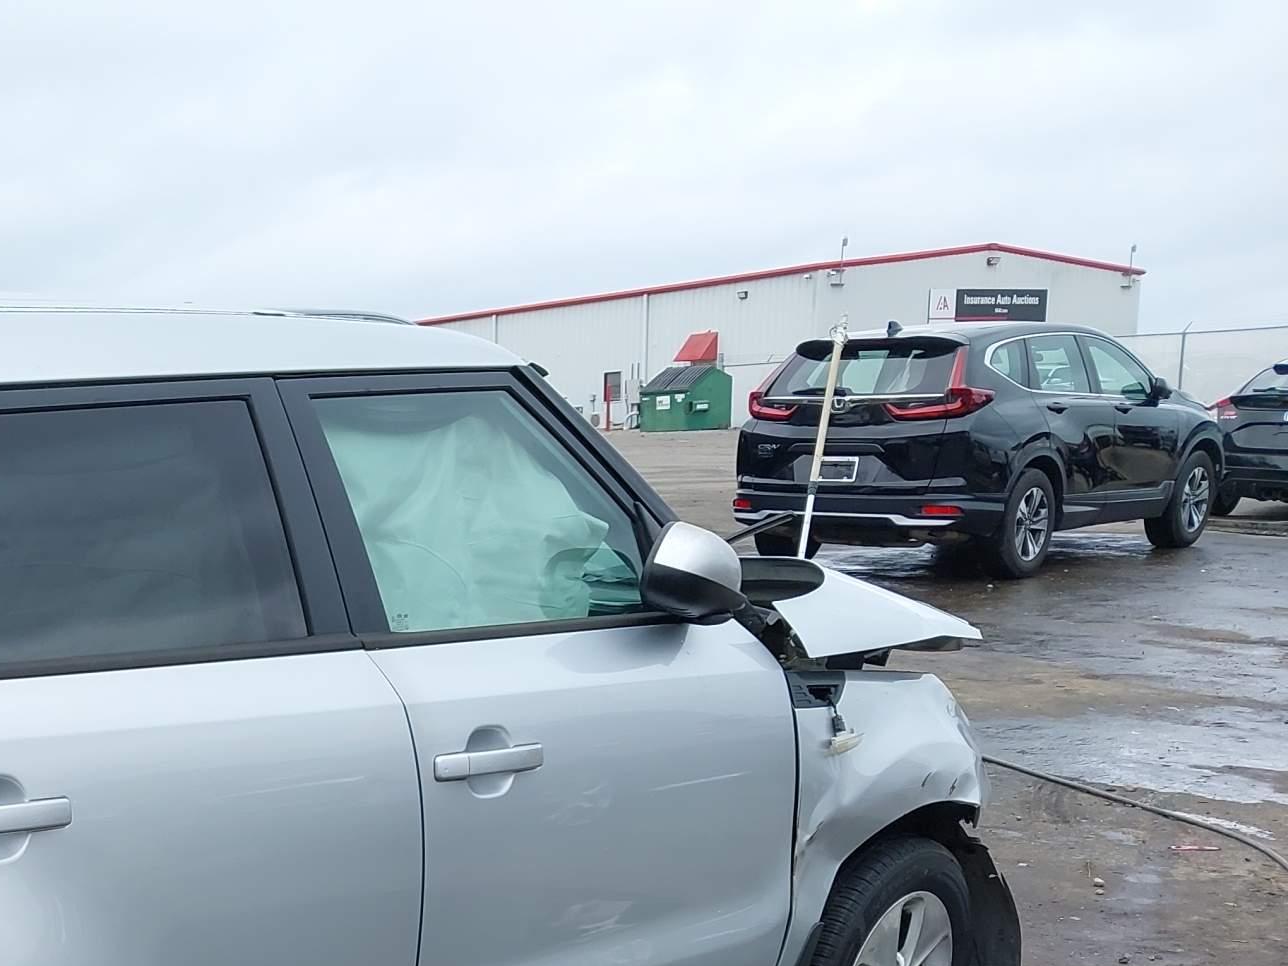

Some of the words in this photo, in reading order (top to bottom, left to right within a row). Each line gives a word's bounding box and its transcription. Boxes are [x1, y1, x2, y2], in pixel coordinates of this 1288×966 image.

[964, 294, 995, 305] Insurance
[996, 294, 1011, 305] Auto
[1012, 294, 1039, 305] Auctions
